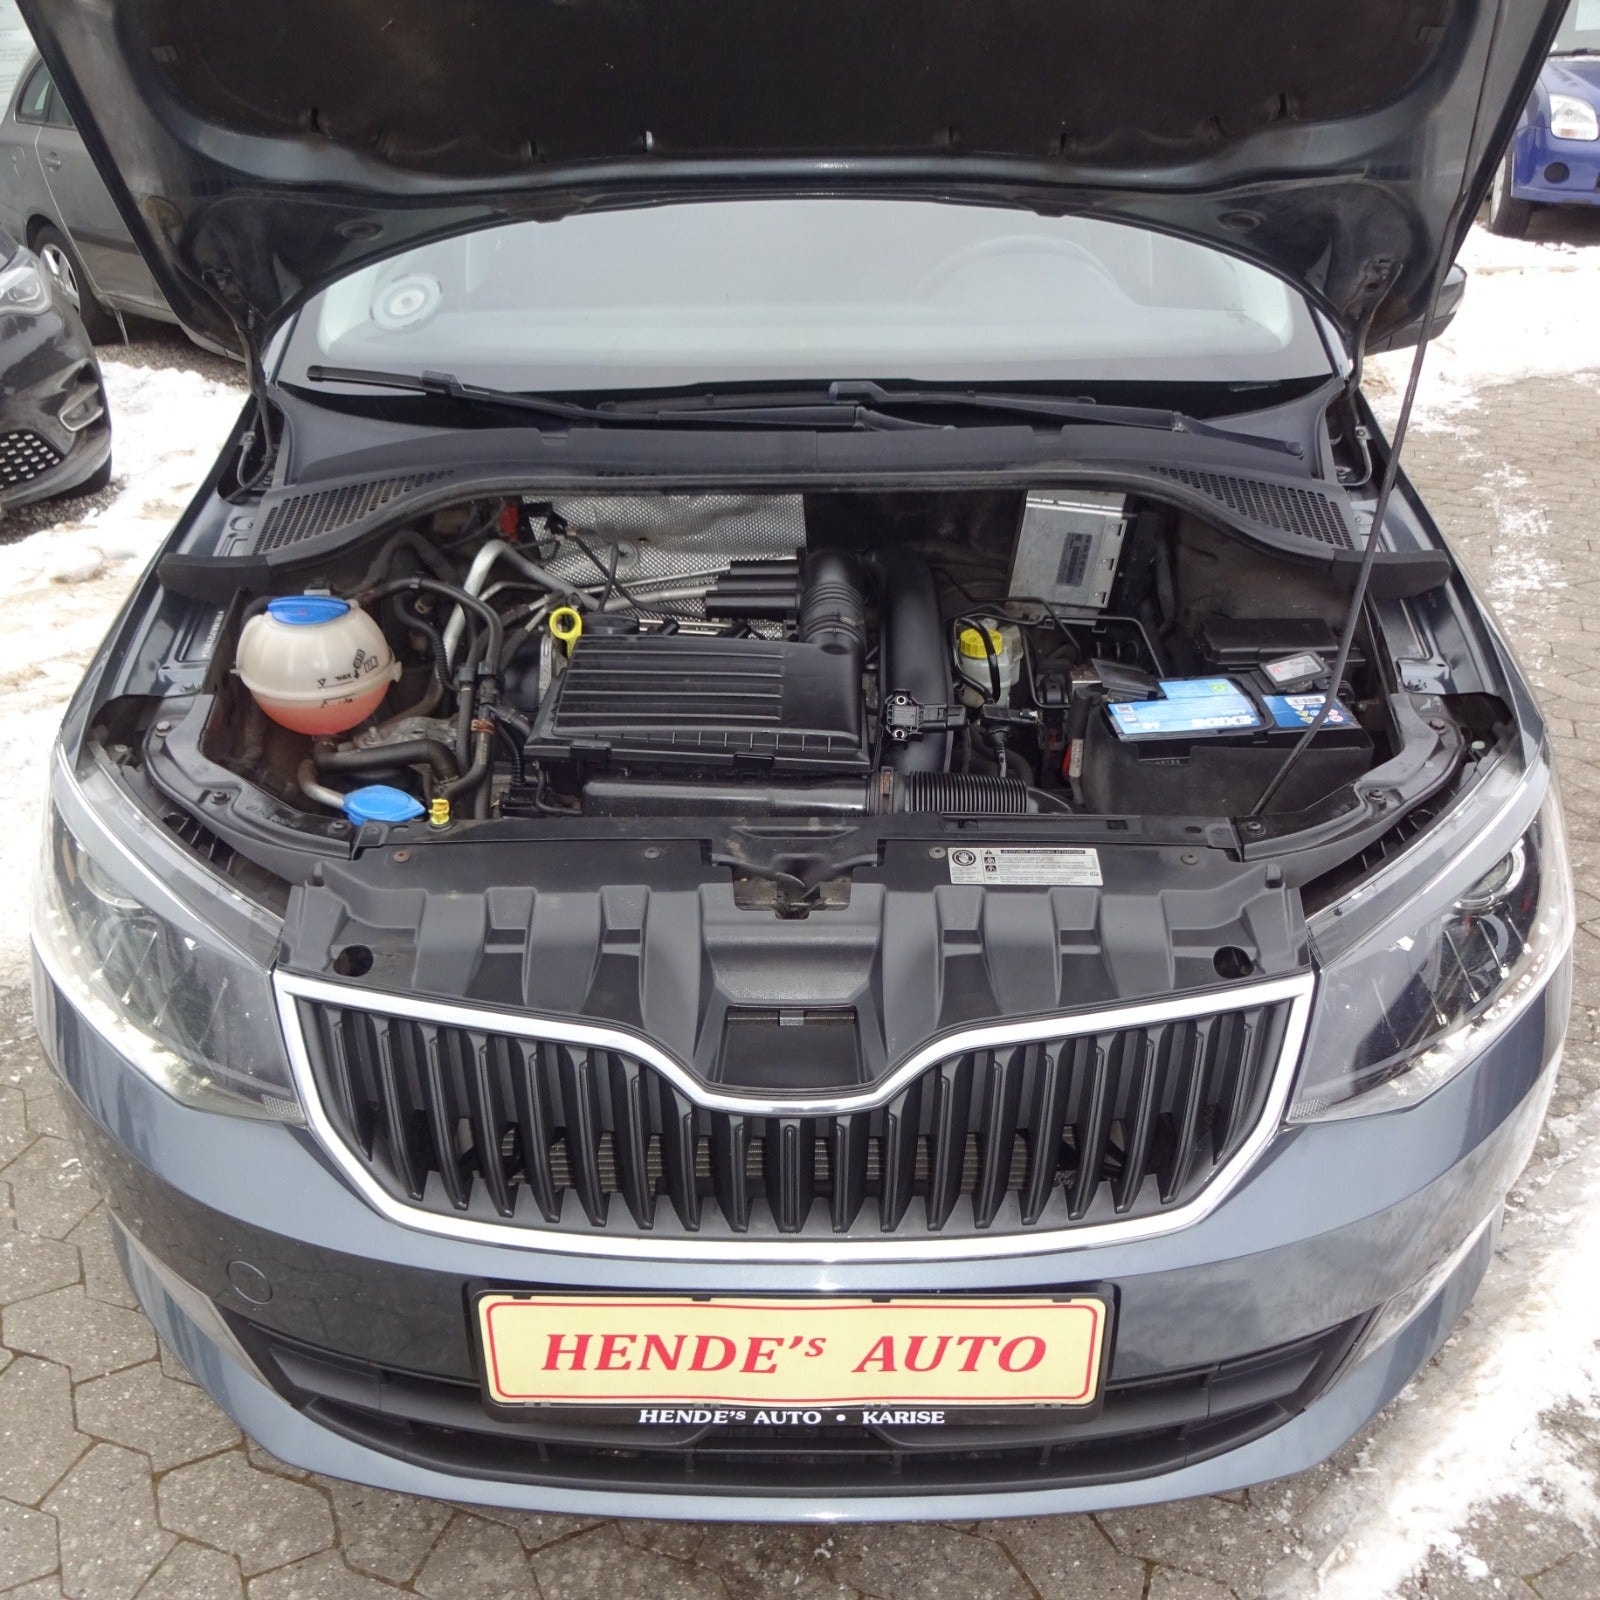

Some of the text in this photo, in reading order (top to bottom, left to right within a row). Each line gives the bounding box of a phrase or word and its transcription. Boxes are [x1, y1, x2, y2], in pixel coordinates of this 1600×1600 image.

[852, 1335, 1047, 1373] AUTO
[753, 1409, 822, 1425] AUTO
[862, 1410, 946, 1425] KARISE
